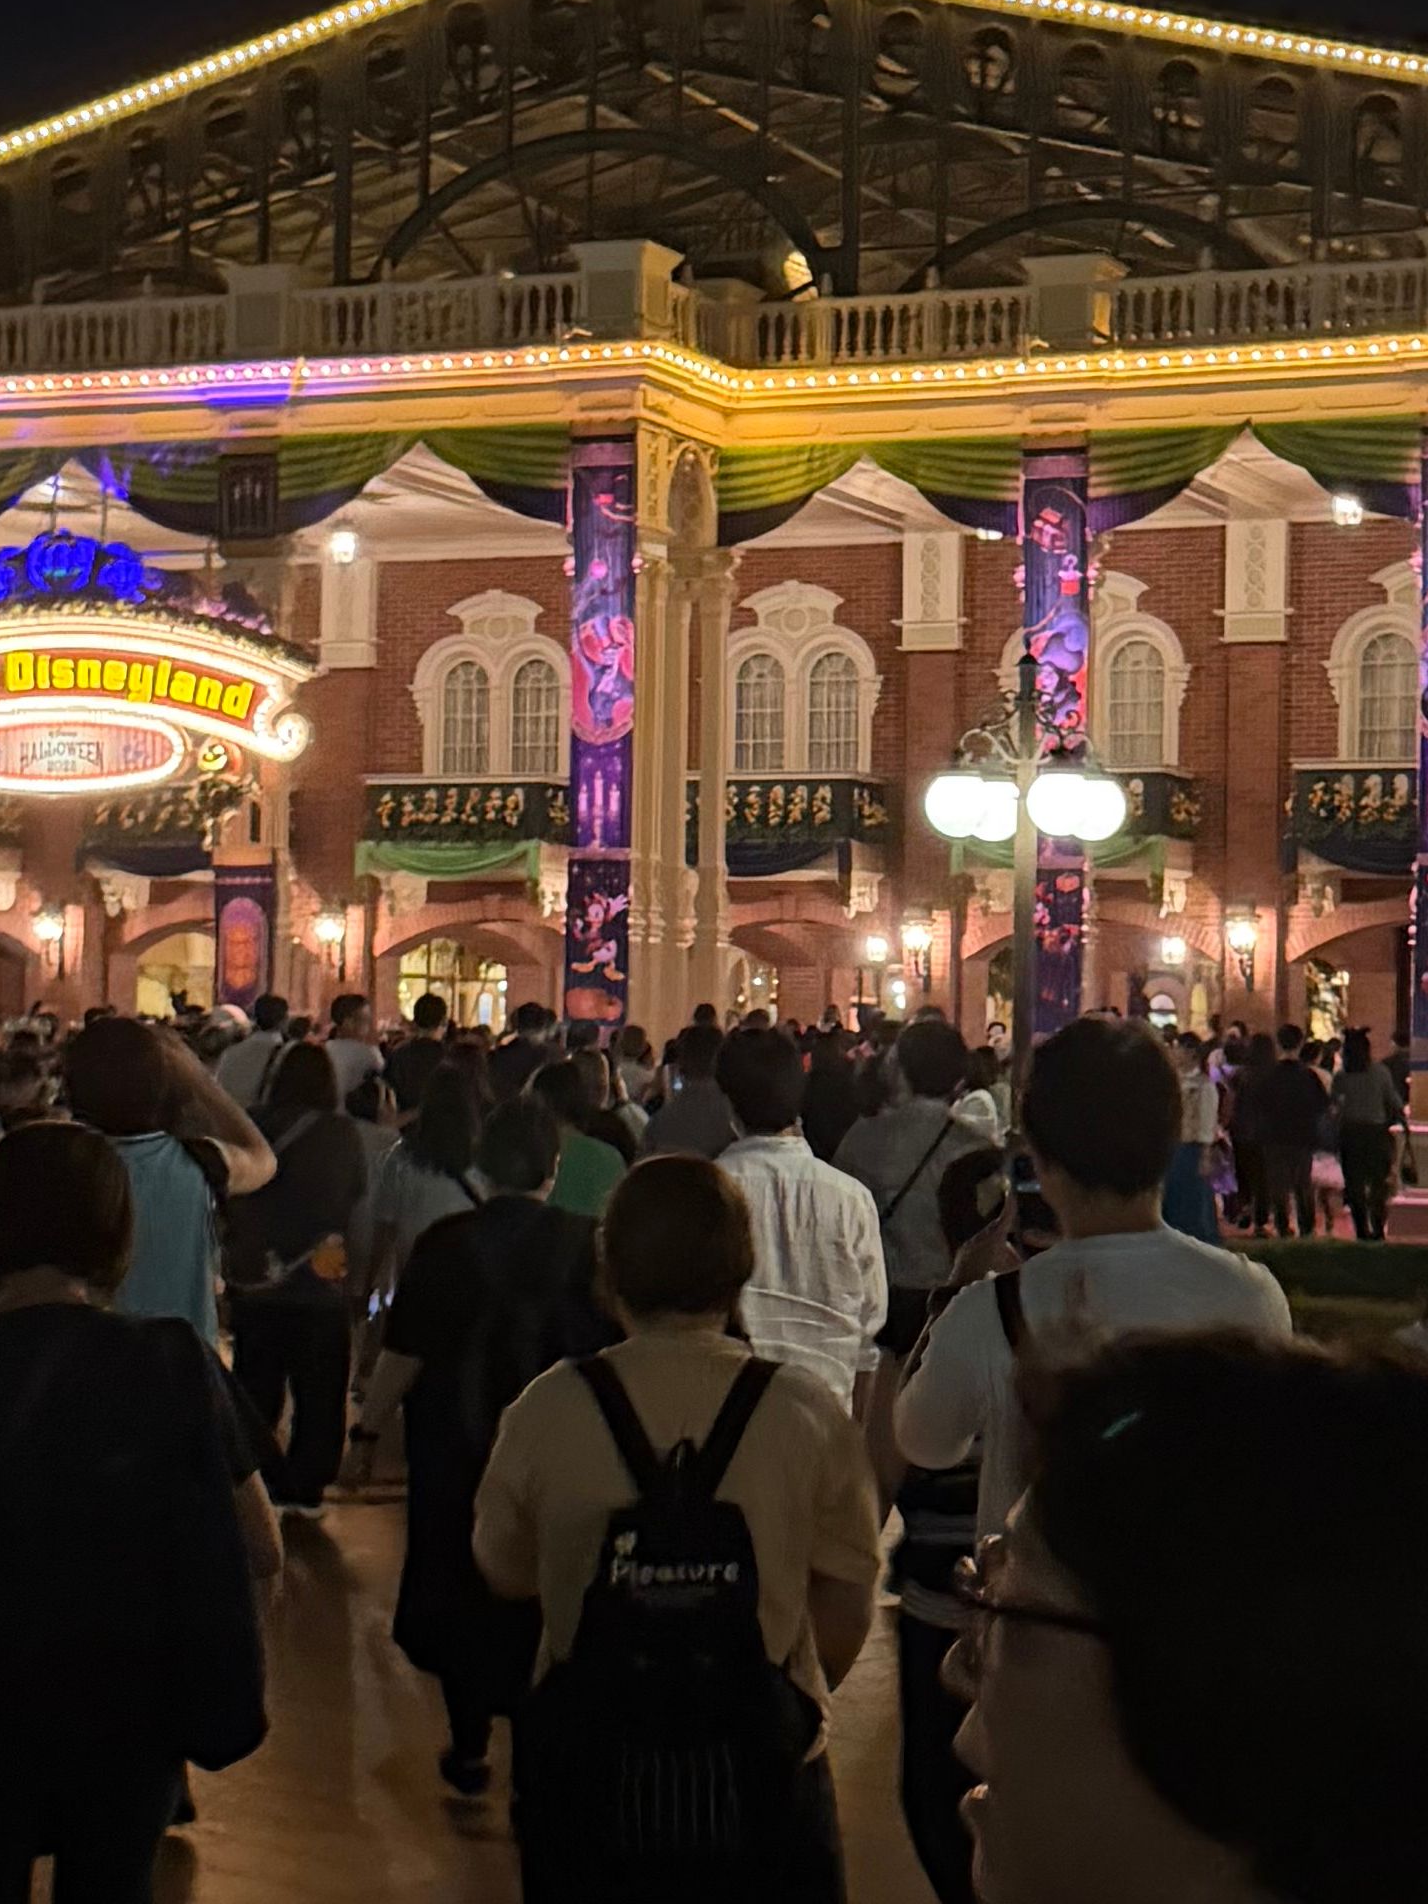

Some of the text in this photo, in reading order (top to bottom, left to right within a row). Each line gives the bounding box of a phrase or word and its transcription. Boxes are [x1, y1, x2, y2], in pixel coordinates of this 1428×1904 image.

[5, 650, 255, 720] Disneyland
[20, 740, 104, 776] HALLOWEEN
[610, 1558, 740, 1583] Pleasure
